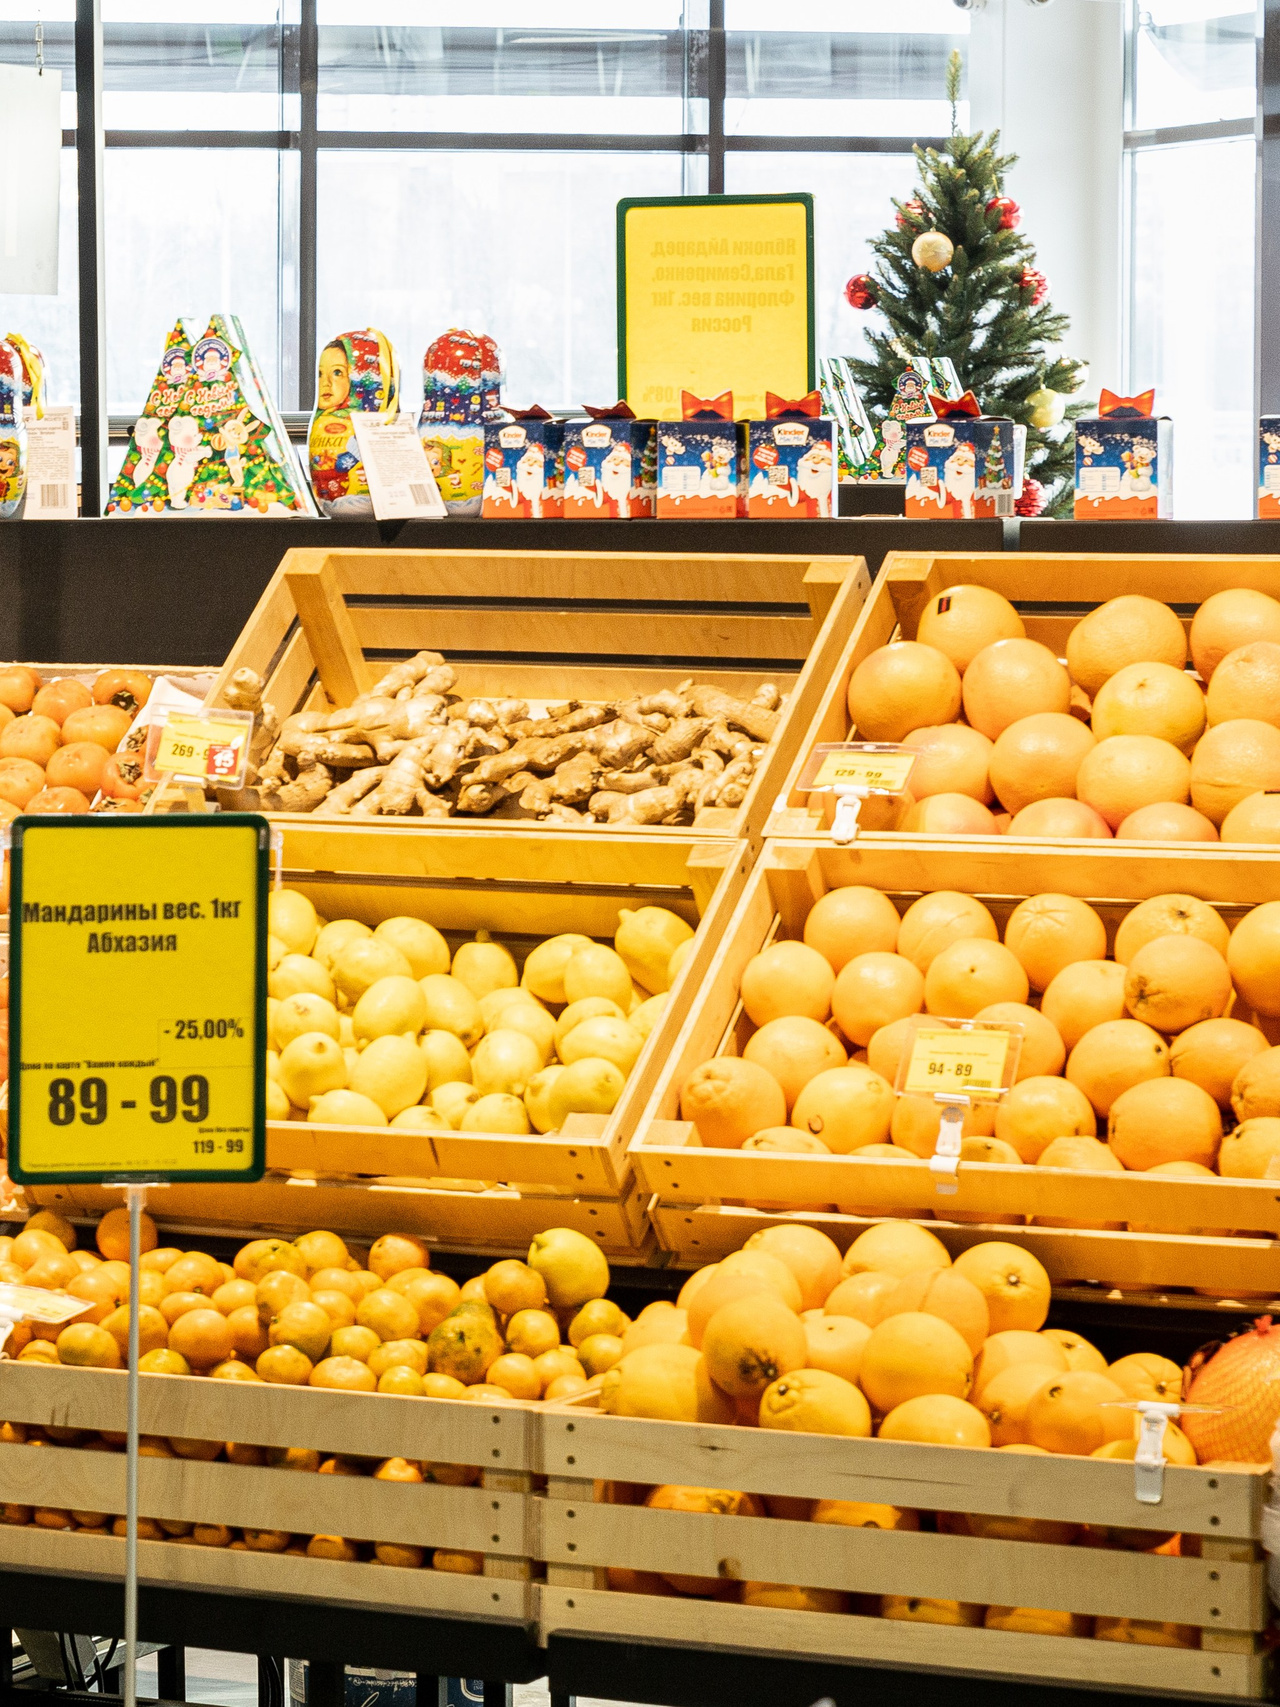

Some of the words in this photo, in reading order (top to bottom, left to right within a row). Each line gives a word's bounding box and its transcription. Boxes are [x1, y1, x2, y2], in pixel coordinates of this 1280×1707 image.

[778, 428, 804, 436] Kinder
[928, 430, 951, 438] Kinder
[171, 744, 194, 758] 269
[22, 902, 157, 925] Мандарины
[163, 901, 205, 920] вес.
[212, 898, 241, 919] 1кг
[87, 932, 177, 953] Абхазия
[174, 1019, 245, 1040] 25,00%
[48, 1076, 108, 1126] 89
[149, 1074, 210, 1124] 99
[193, 1139, 214, 1153] 119
[226, 1139, 243, 1153] 99
